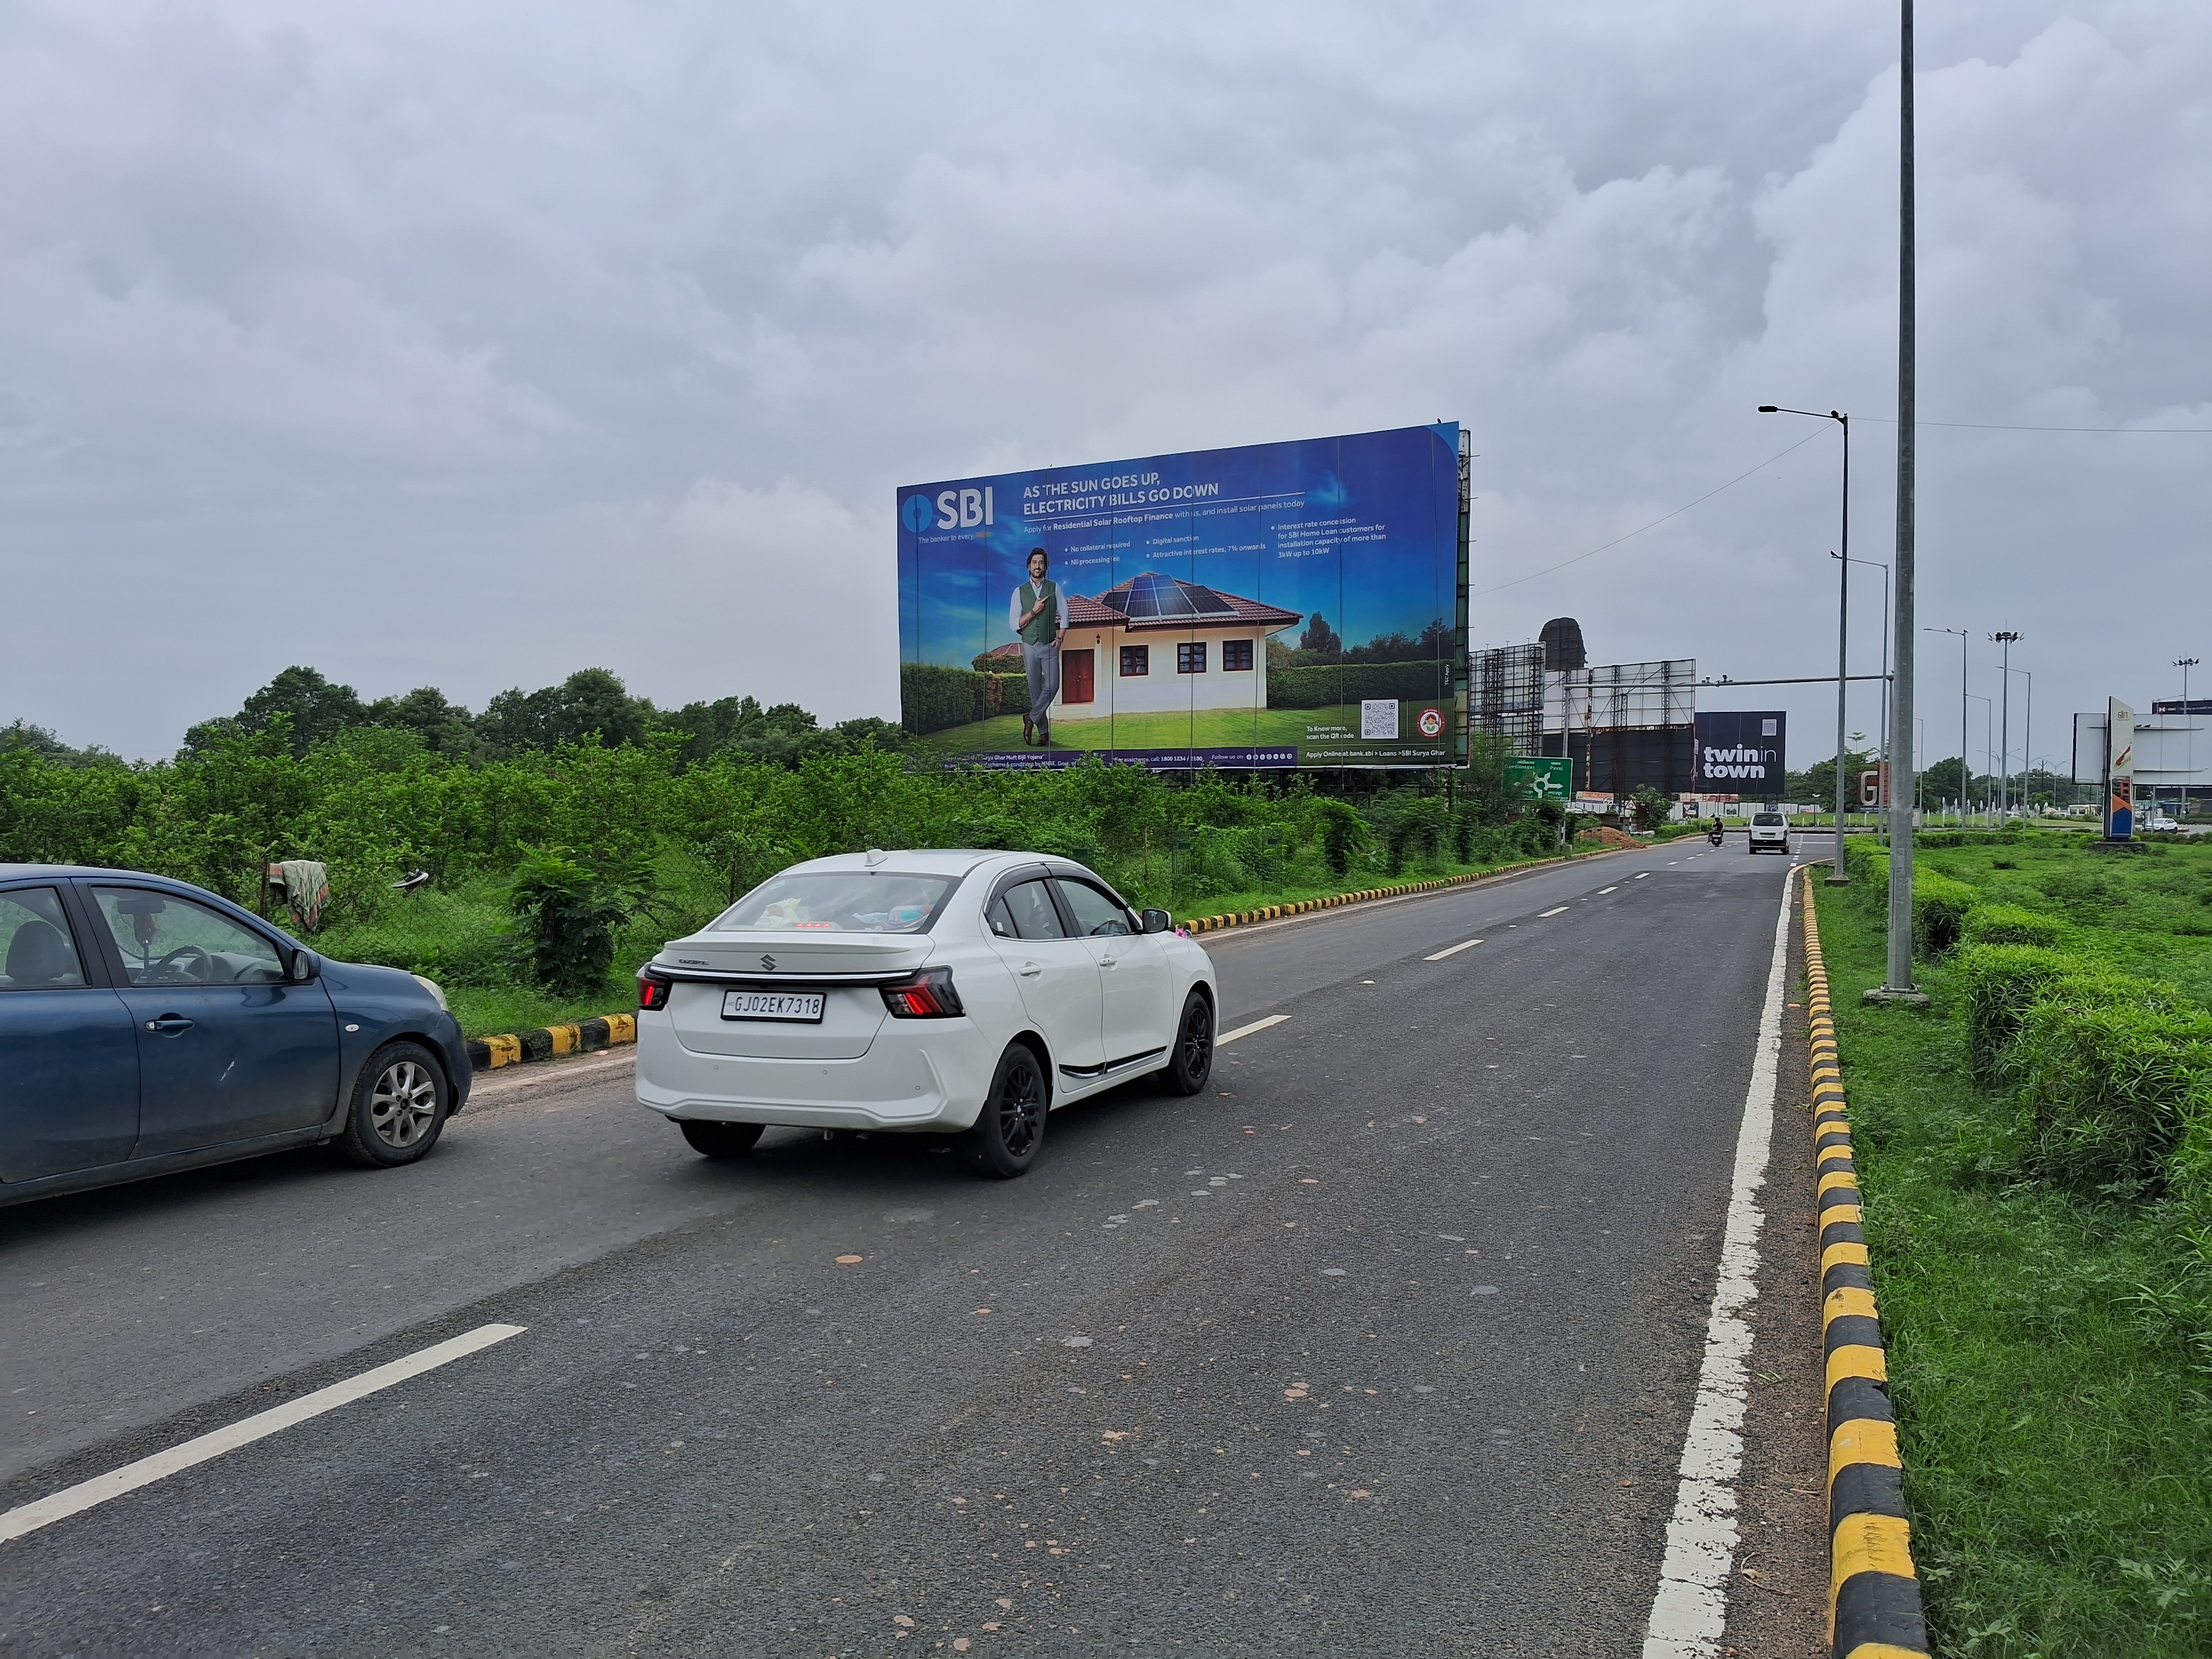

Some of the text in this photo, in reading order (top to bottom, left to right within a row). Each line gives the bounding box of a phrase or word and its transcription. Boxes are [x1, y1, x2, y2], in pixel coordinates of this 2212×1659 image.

[1024, 472, 1160, 499] AS THE SUN GOES UP,
[1024, 483, 1218, 515] ELECTRICITY BILLS GO DOWN
[937, 486, 993, 530] SBI
[1024, 525, 1041, 534] Apply
[1043, 524, 1052, 532] for
[1053, 518, 1092, 531] Residential
[1093, 517, 1112, 527] Solar
[1113, 513, 1143, 526] Rooftop
[1144, 512, 1173, 522] Finance
[1174, 510, 1189, 518] with
[1202, 507, 1216, 516] and
[1217, 505, 1238, 515] install
[1239, 504, 1257, 512] solar
[1258, 502, 1282, 512] panels
[1283, 499, 1304, 509] today
[1278, 523, 1303, 531] Interest
[1319, 517, 1356, 526] concession
[1339, 526, 1374, 534] customers
[1080, 543, 1105, 552] collateral
[1106, 541, 1130, 551] required
[1153, 535, 1199, 545] Digital sanction
[1278, 539, 1314, 549] installation
[1315, 537, 1342, 546] capacity
[1153, 550, 1183, 559] Attractive
[1184, 548, 1208, 556] interest
[1209, 546, 1226, 555] rates,
[1239, 543, 1265, 551] onwards
[1079, 556, 1110, 566] processing
[1306, 751, 1322, 759] Apply
[1703, 763, 1765, 779] town
[735, 996, 820, 1014] GJ02EK7318
